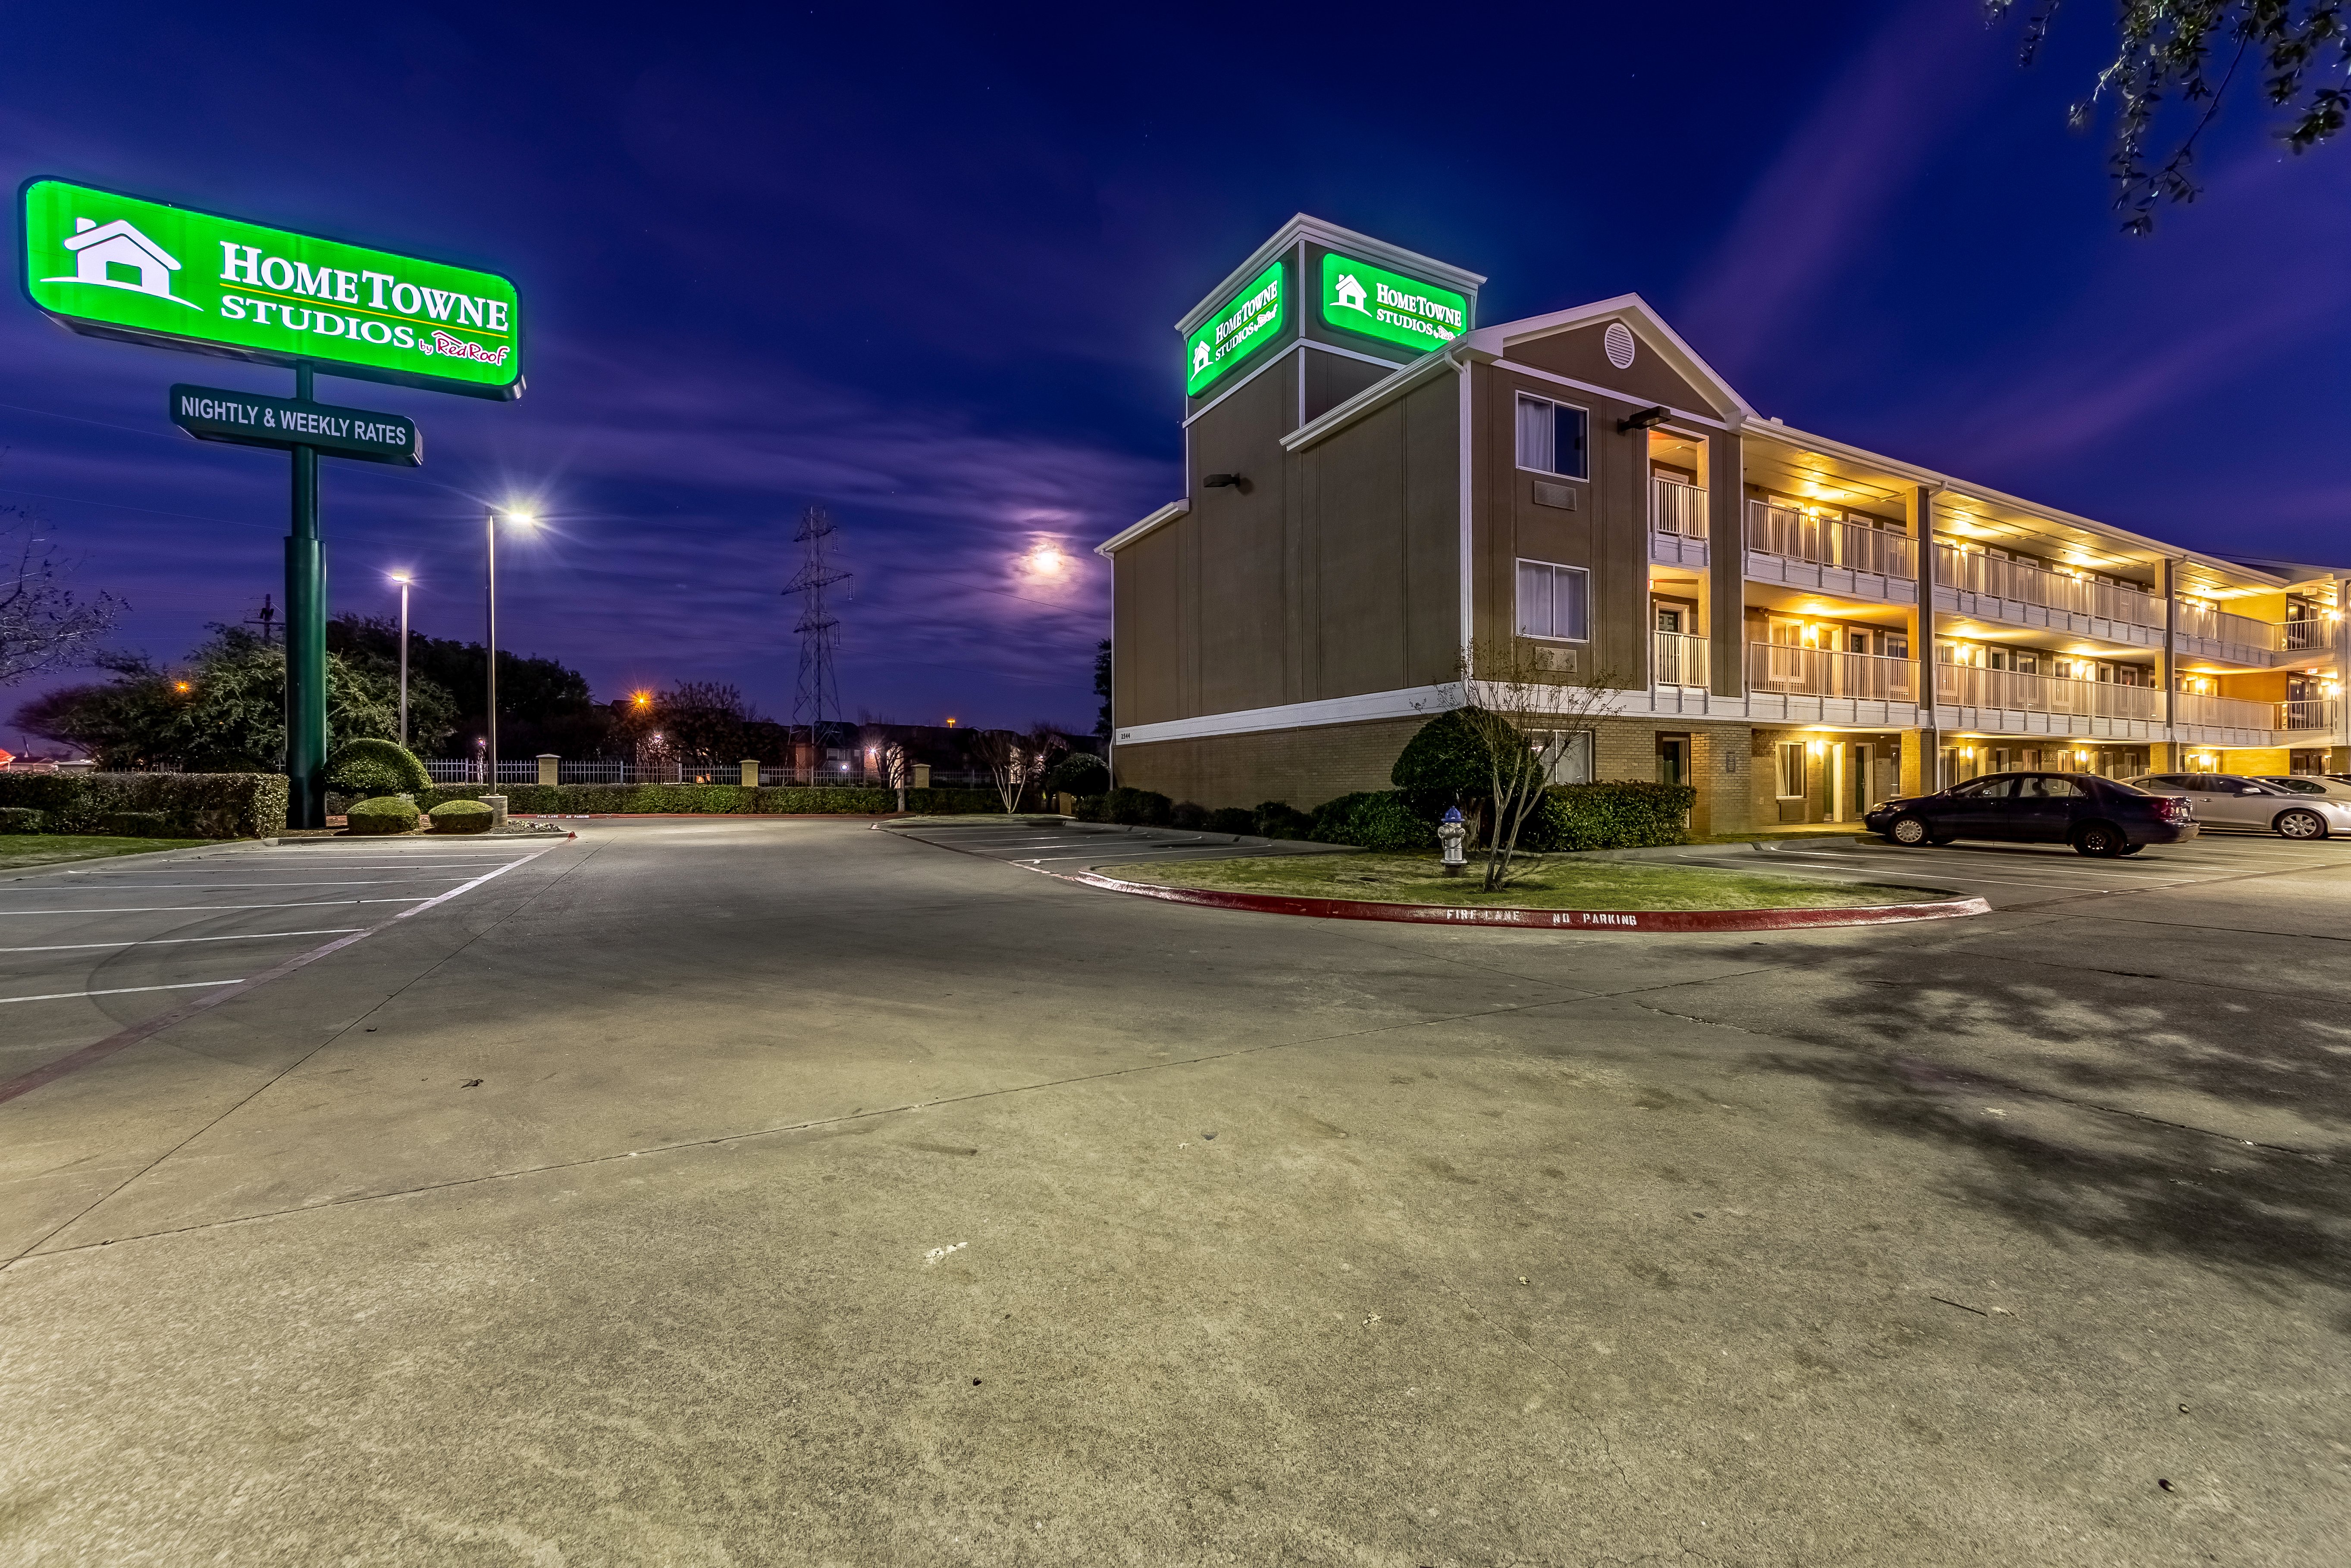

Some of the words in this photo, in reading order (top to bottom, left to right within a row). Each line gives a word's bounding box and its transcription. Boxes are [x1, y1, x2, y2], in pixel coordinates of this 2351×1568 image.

[219, 241, 508, 332] HOMETOWNE
[1376, 282, 1462, 327] HOMETOWNE
[221, 295, 414, 348] STUDIOS
[1215, 280, 1278, 345] HOMETOWNE
[1376, 308, 1433, 335] STUDIOS
[420, 339, 433, 354] by
[1215, 322, 1254, 361] STUDIOS
[182, 395, 259, 425] NIGHTLY
[263, 408, 276, 428] &
[280, 410, 350, 438] WEEKLY
[354, 421, 406, 445] RATES
[1447, 909, 1477, 920] FIRE
[1553, 913, 1570, 923] NO
[1583, 913, 1637, 926] PARKING
